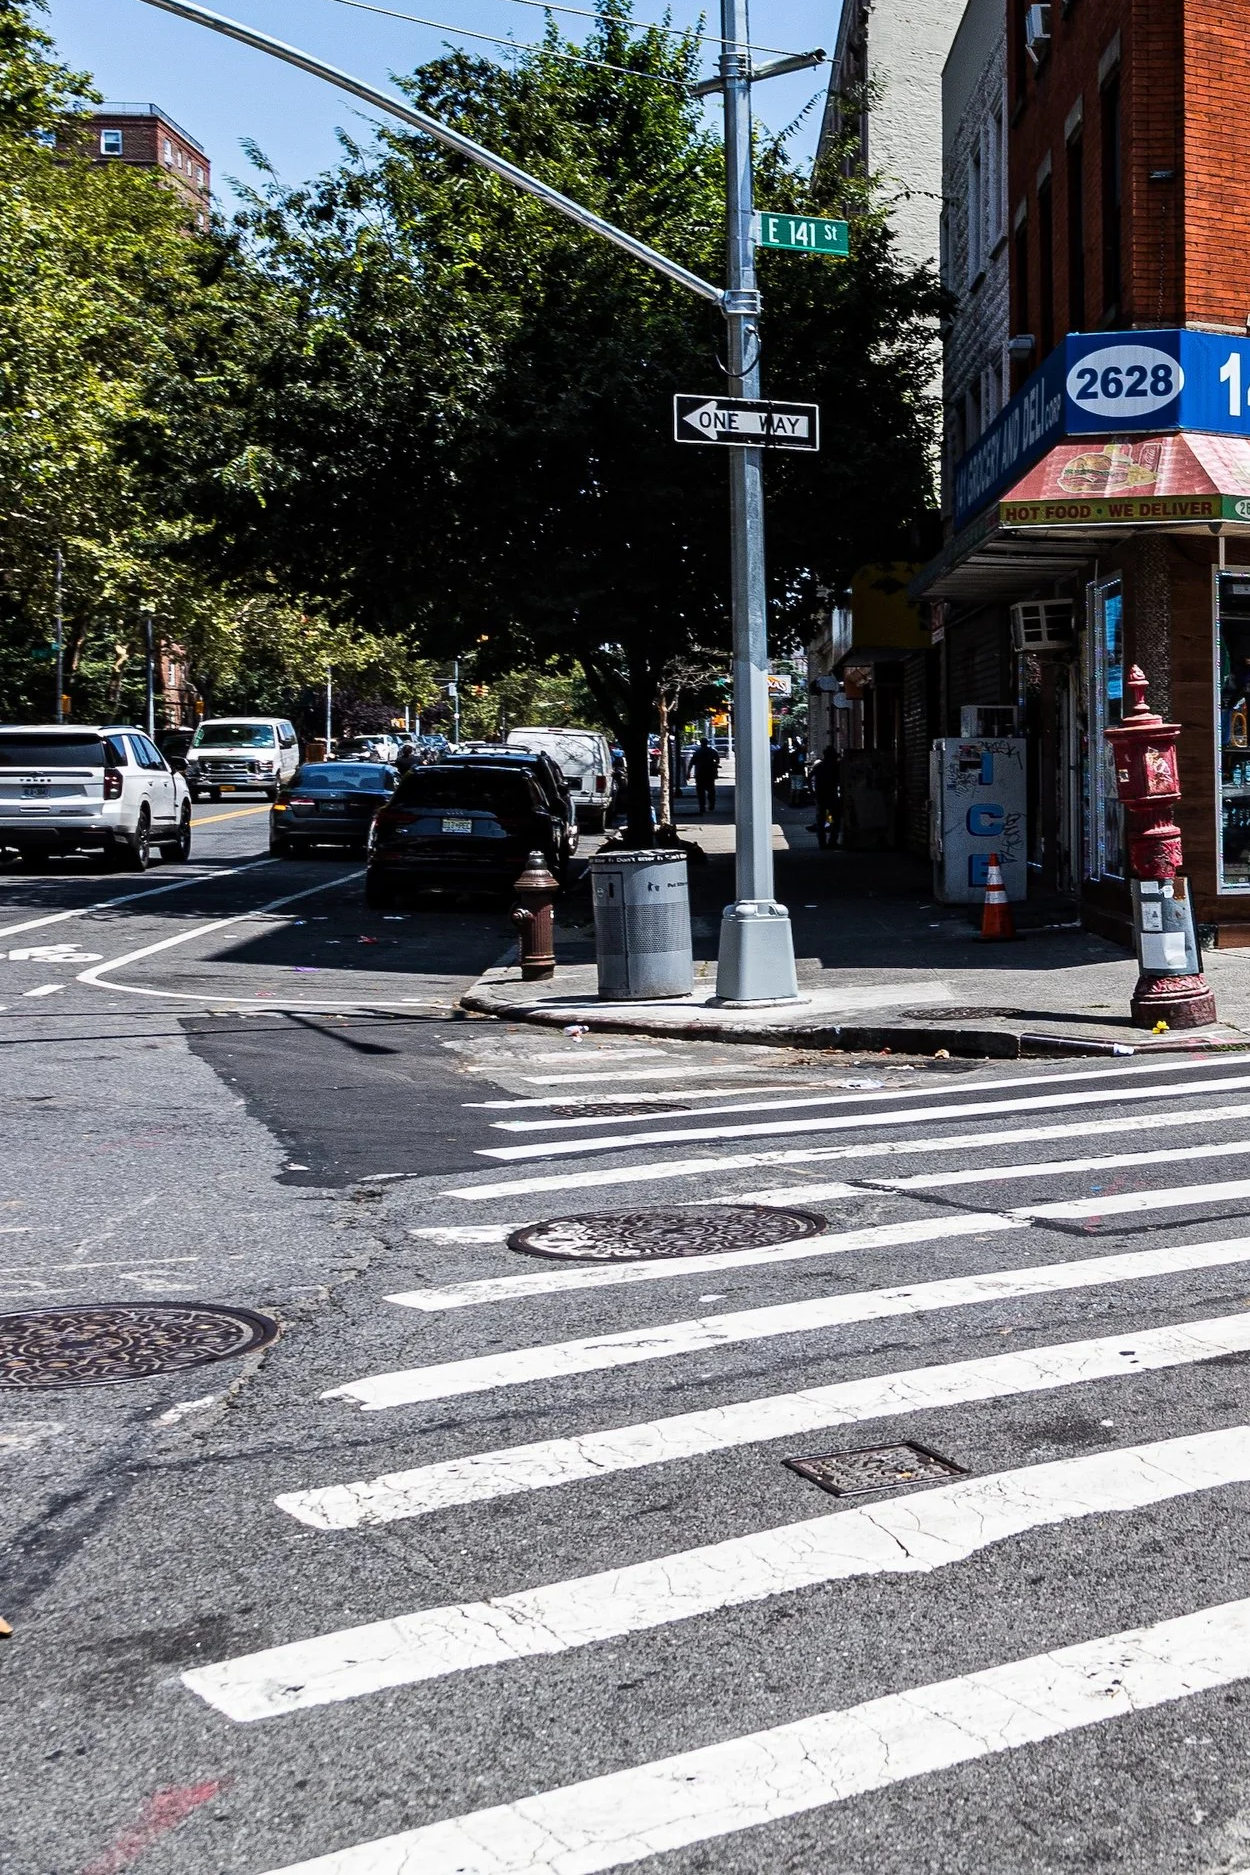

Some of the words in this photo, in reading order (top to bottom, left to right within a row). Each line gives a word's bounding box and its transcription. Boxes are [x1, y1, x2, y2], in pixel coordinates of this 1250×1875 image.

[768, 217, 780, 244] E
[788, 220, 816, 248] 141
[824, 223, 838, 241] St
[1074, 363, 1174, 401] 2628
[699, 411, 739, 431] ONE
[758, 414, 800, 435] WAY
[1001, 406, 1020, 474] AND
[1022, 376, 1045, 453] DELI
[1005, 506, 1041, 522] HOT
[1045, 505, 1092, 520] FOOD
[1108, 503, 1135, 518] WE
[1139, 500, 1213, 517] DELIVER
